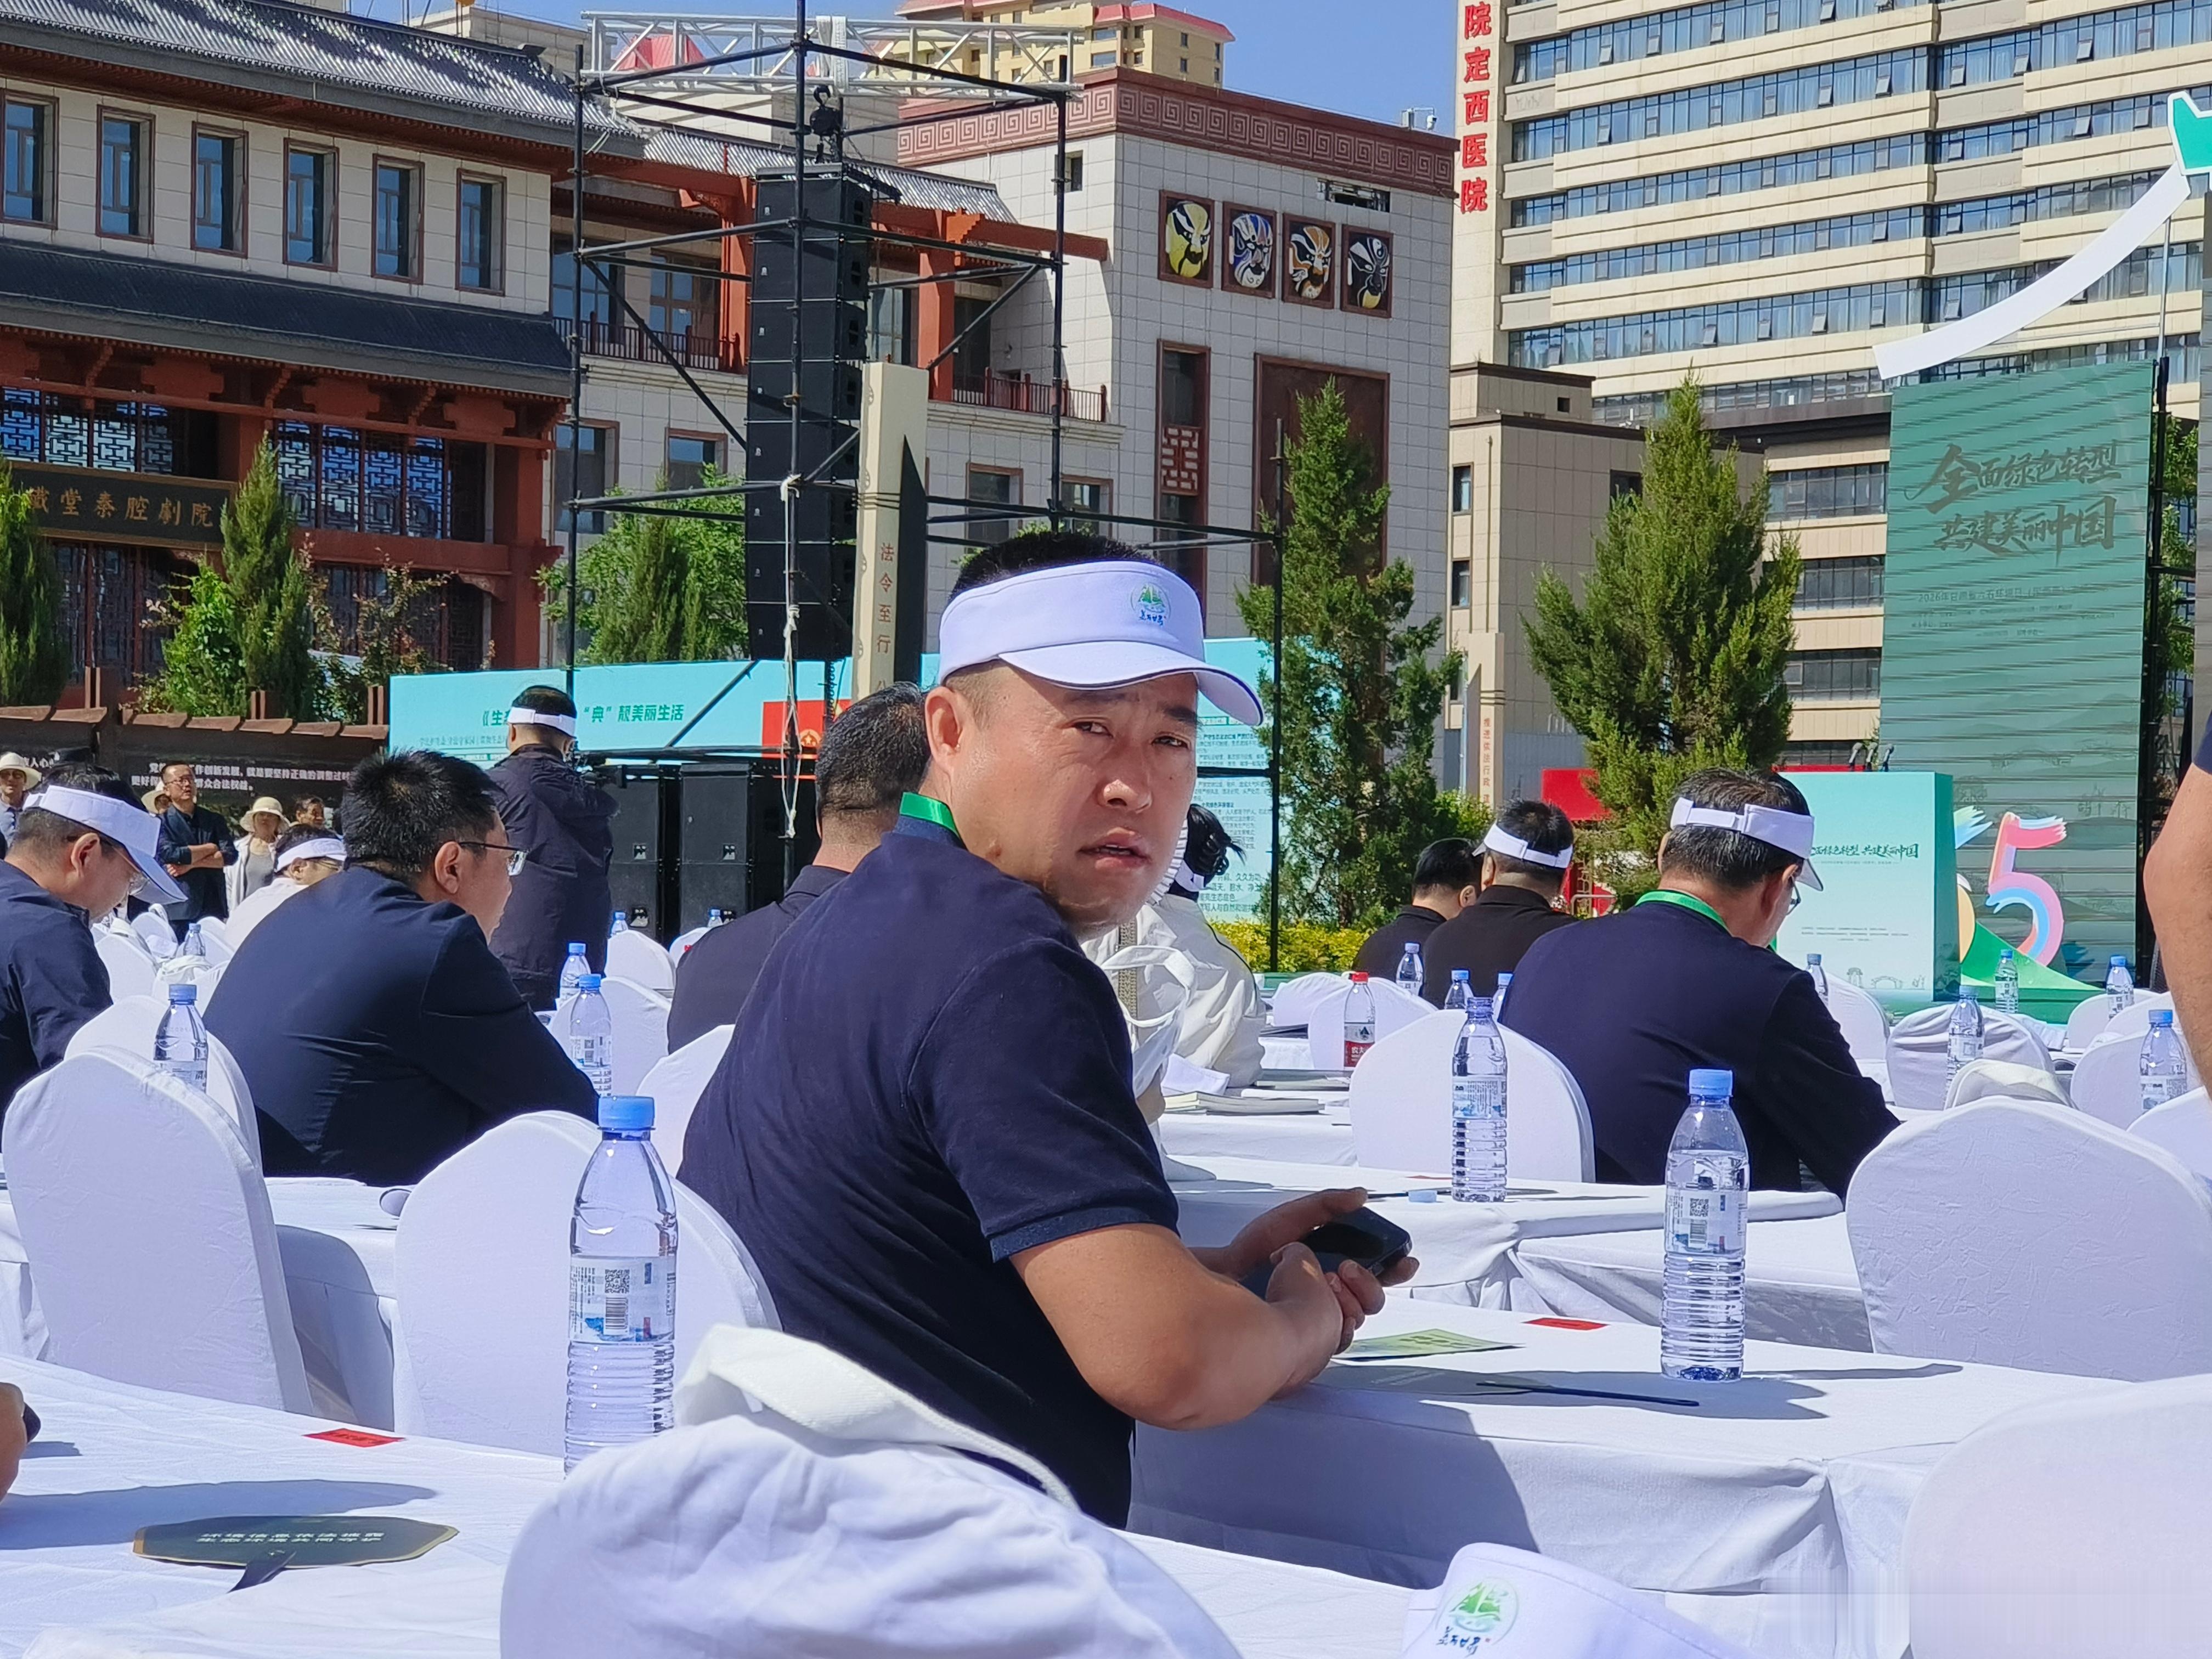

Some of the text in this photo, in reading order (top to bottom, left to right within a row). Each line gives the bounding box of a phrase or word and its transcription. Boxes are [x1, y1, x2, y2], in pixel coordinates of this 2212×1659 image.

[1460, 2, 1492, 214] 院定西医院
[1904, 437, 2122, 515] 全面绿色转型
[1934, 495, 2117, 568] 共建美丽中国
[877, 542, 895, 654] 法令至行
[1861, 843, 1919, 861] 共建美丽中国
